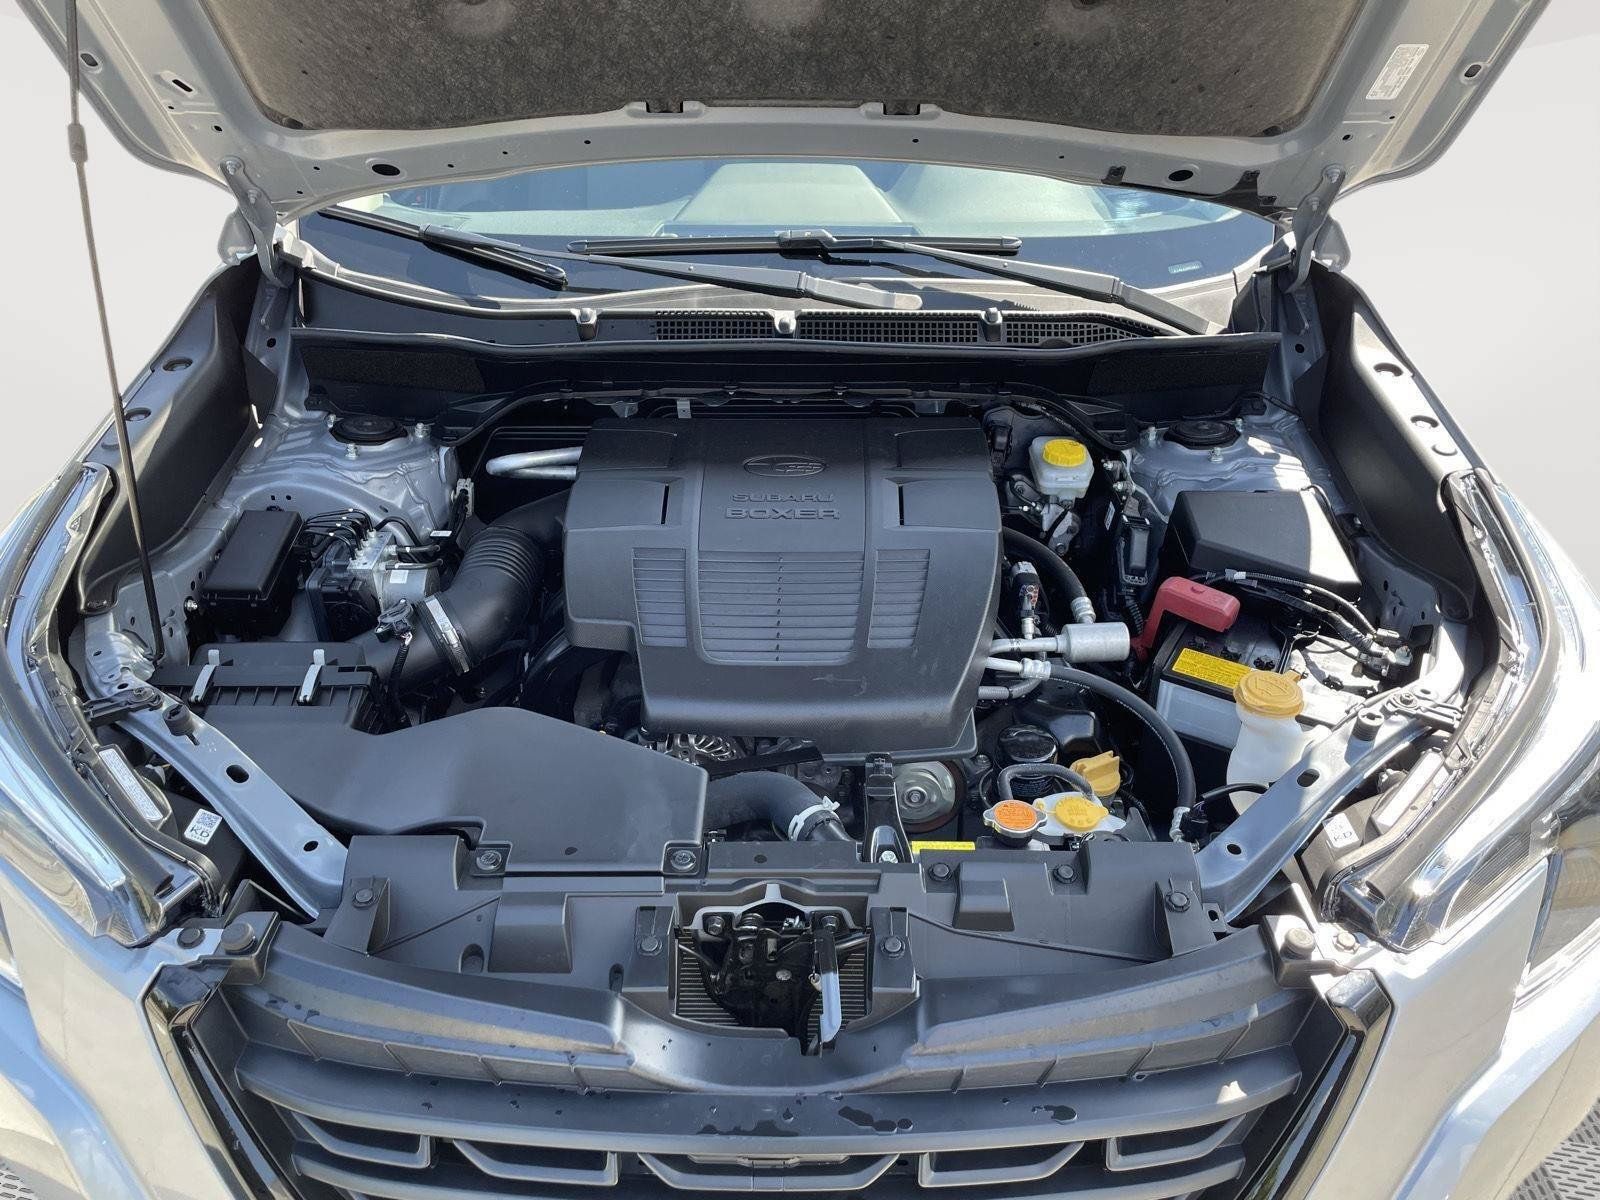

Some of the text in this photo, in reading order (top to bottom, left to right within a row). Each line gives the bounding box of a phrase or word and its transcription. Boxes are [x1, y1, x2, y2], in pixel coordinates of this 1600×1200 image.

[731, 492, 835, 503] SUBARU
[725, 507, 840, 520] BOXER
[190, 825, 210, 838] KD
